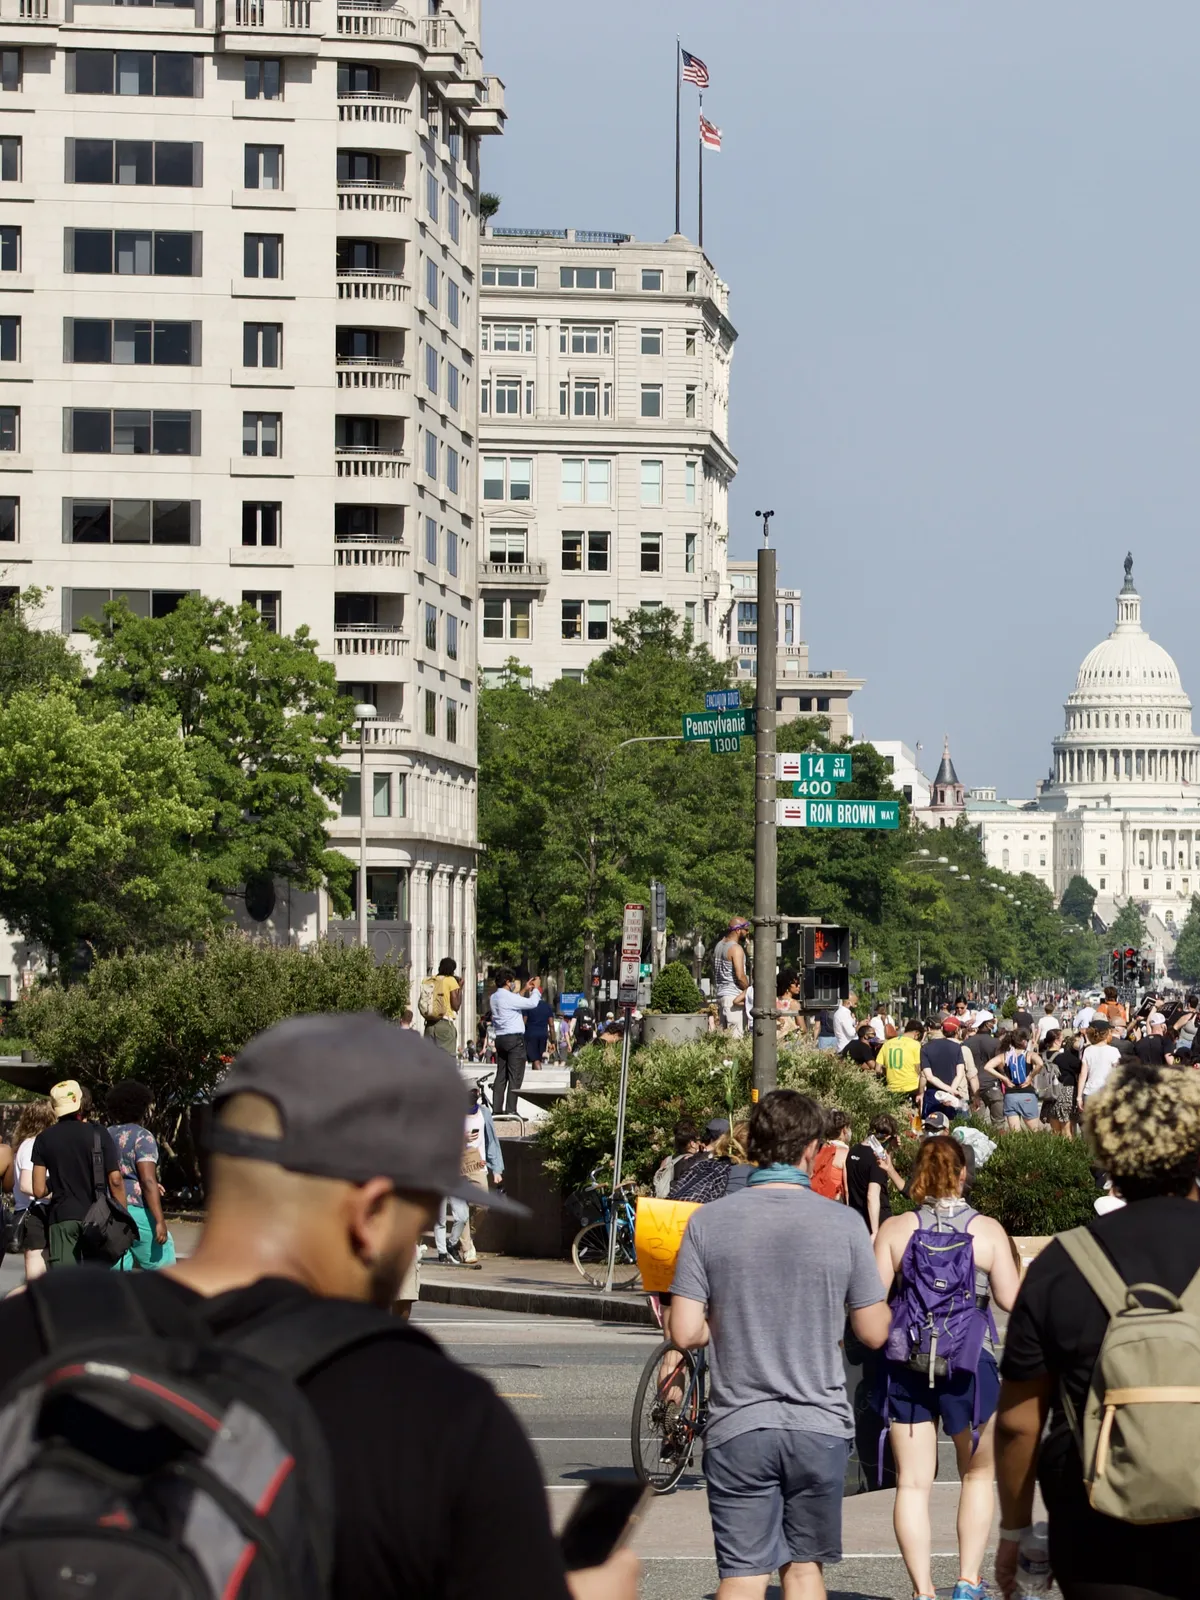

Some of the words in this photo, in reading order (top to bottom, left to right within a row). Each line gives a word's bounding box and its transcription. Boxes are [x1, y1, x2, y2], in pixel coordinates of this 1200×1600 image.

[727, 691, 739, 706] ROUTE
[685, 712, 746, 737] Pennsylvania
[715, 737, 738, 752] 1300
[808, 757, 825, 778] 14
[834, 758, 845, 768] ST
[833, 768, 846, 778] NW
[798, 781, 831, 795] 400
[810, 803, 833, 823] RON
[837, 804, 876, 825] BROWN
[880, 810, 895, 820] WAY
[888, 1047, 903, 1069] 10
